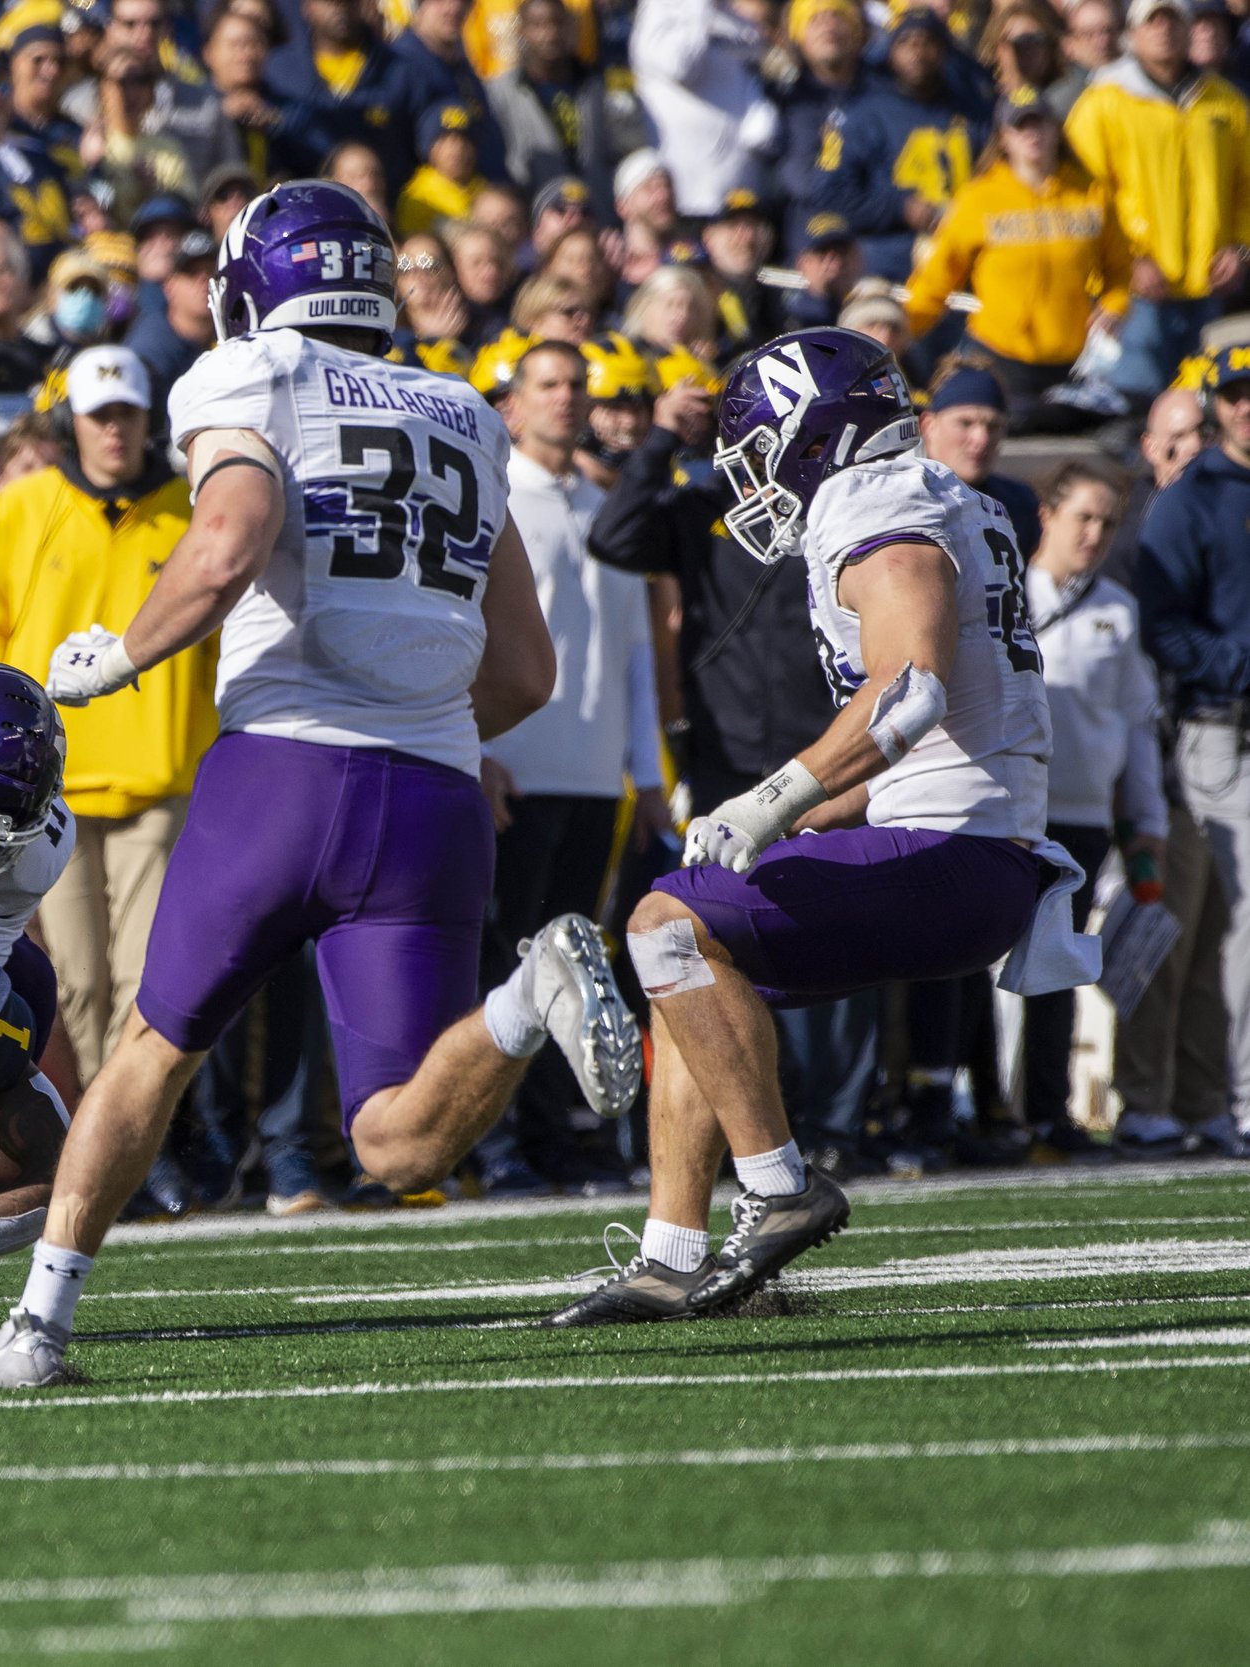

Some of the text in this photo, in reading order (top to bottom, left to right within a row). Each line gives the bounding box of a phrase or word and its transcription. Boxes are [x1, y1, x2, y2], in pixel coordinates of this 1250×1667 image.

[319, 241, 372, 280] 32
[309, 301, 380, 317] WILDCATS
[324, 367, 482, 445] GALLAGHER
[756, 341, 821, 418] N
[329, 424, 479, 600] 32
